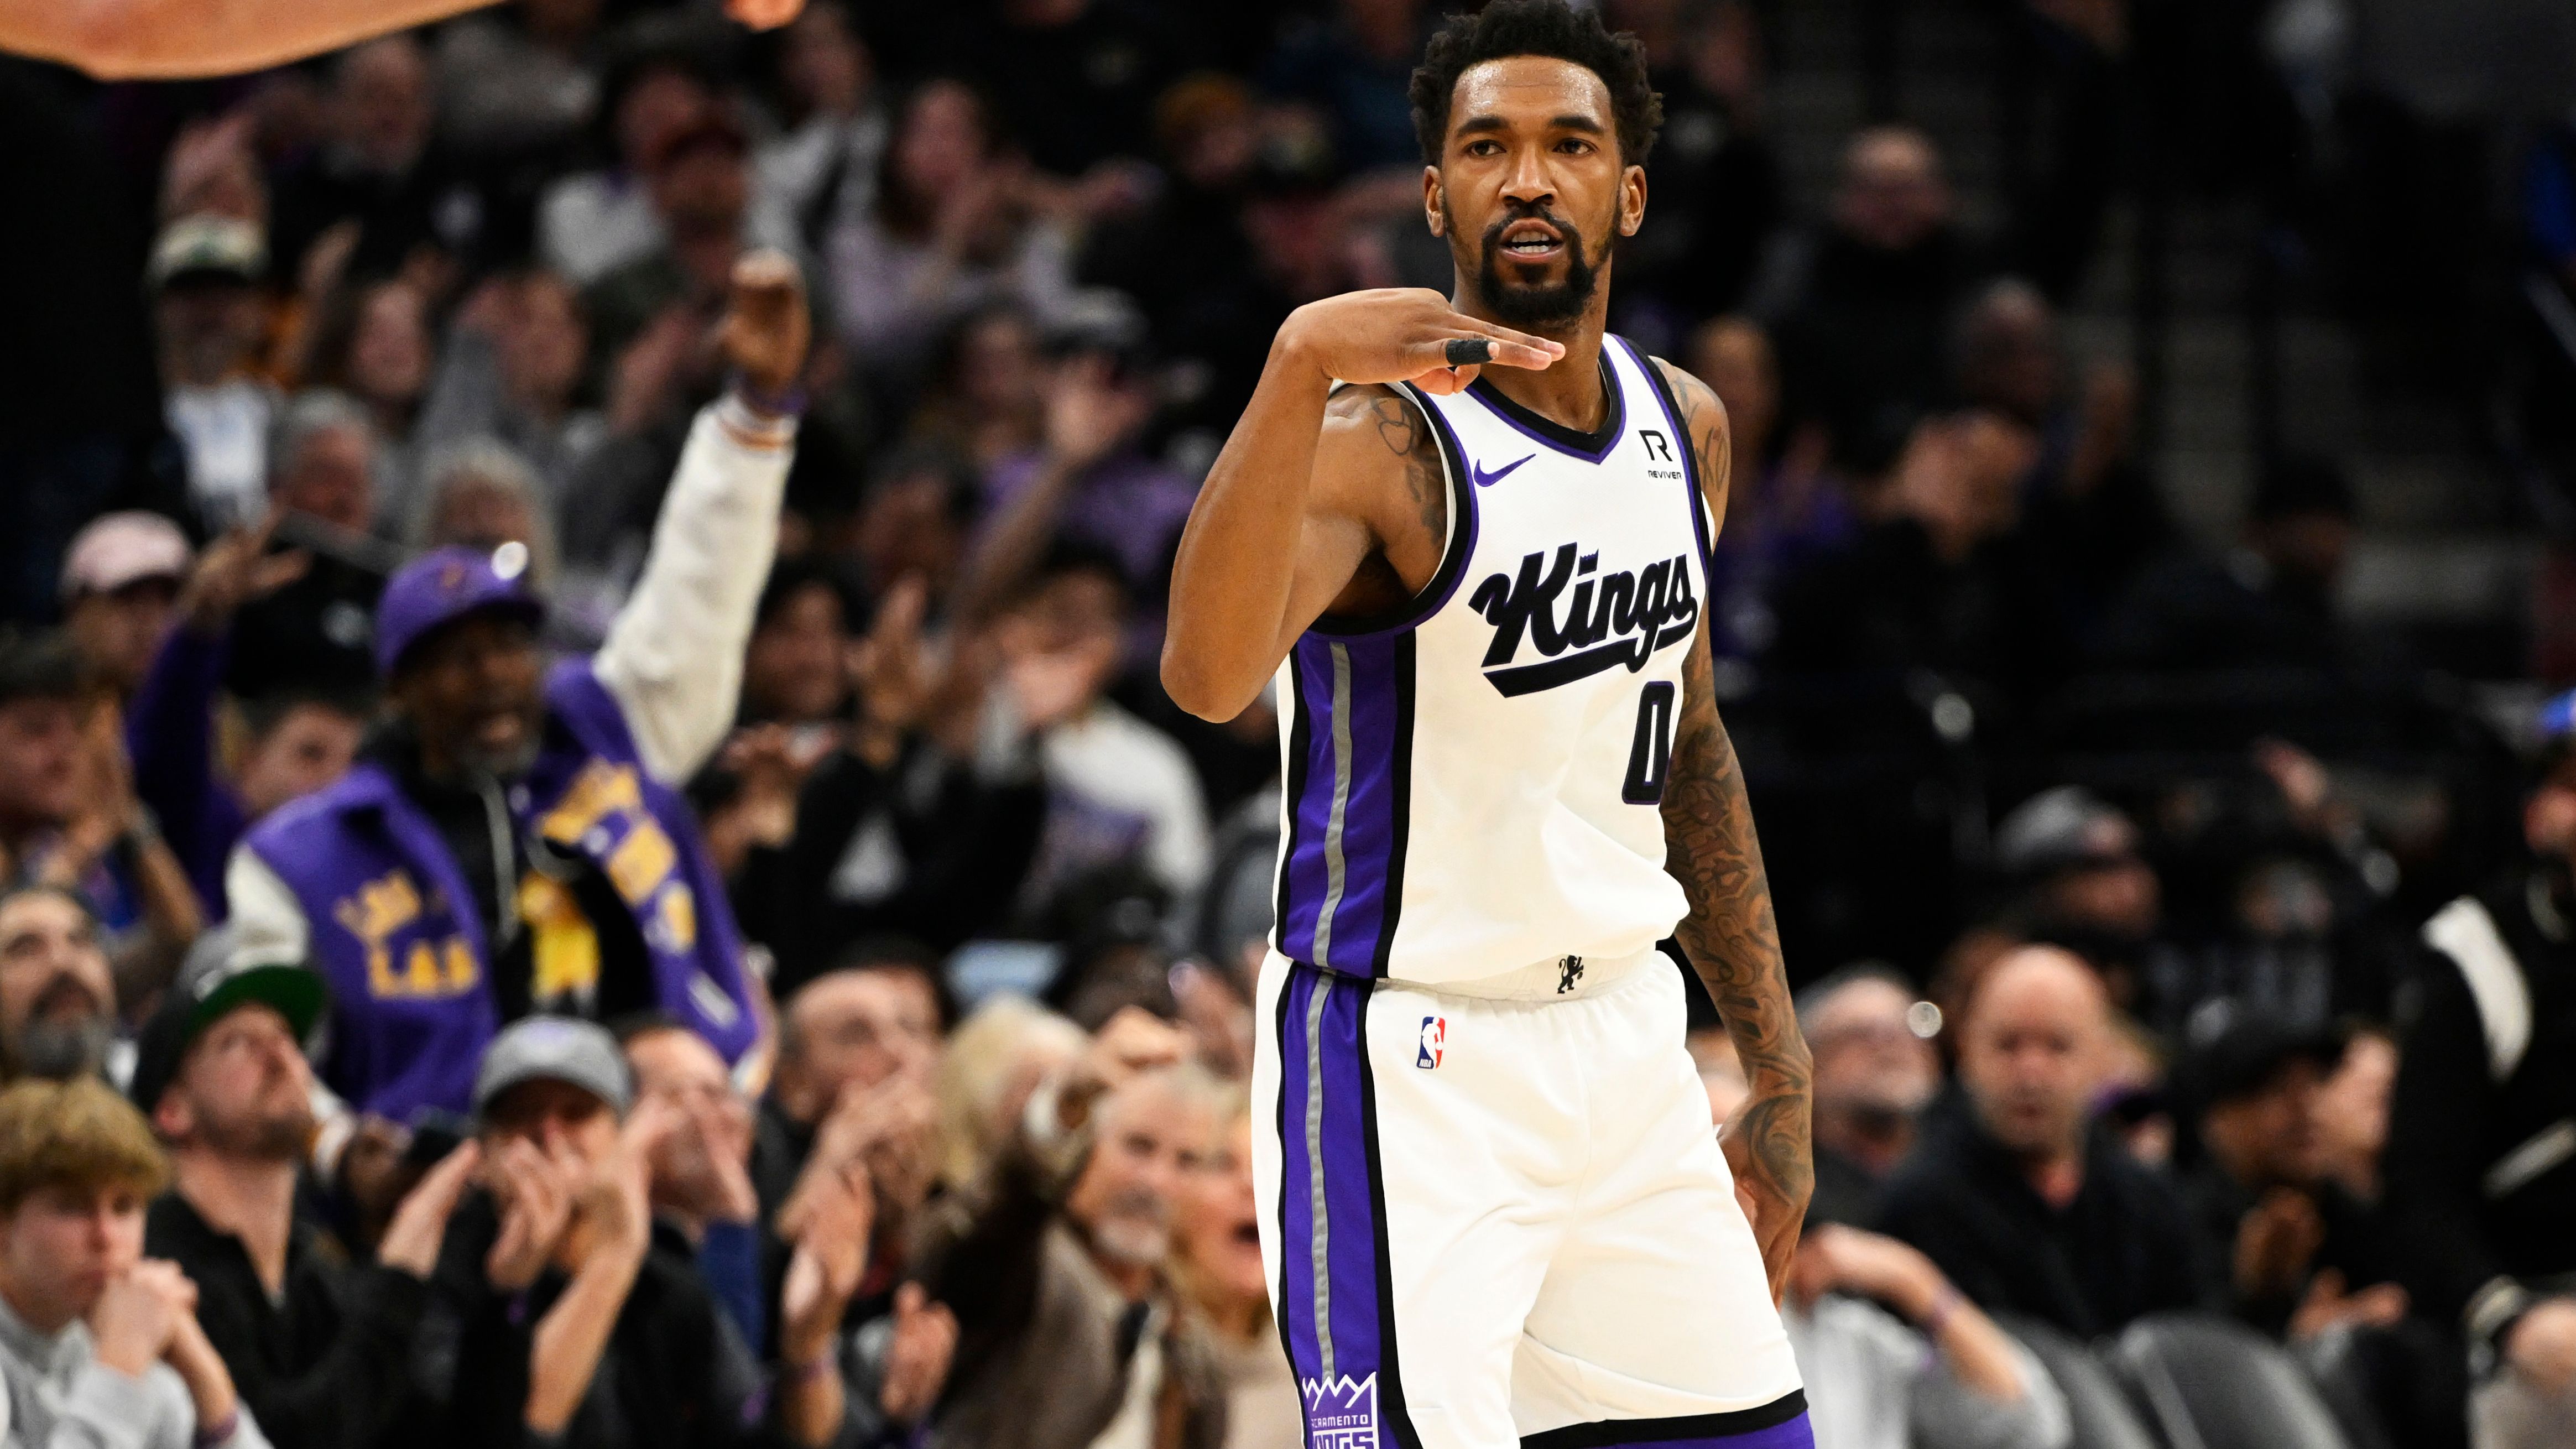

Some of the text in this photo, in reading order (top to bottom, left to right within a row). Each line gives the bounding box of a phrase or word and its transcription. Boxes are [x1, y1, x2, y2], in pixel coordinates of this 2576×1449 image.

[1638, 430, 1673, 462] R
[1647, 470, 1682, 480] REVIVER
[1468, 541, 1698, 698] Kings
[1621, 680, 1675, 805] 0
[1419, 1058, 1432, 1068] NBA
